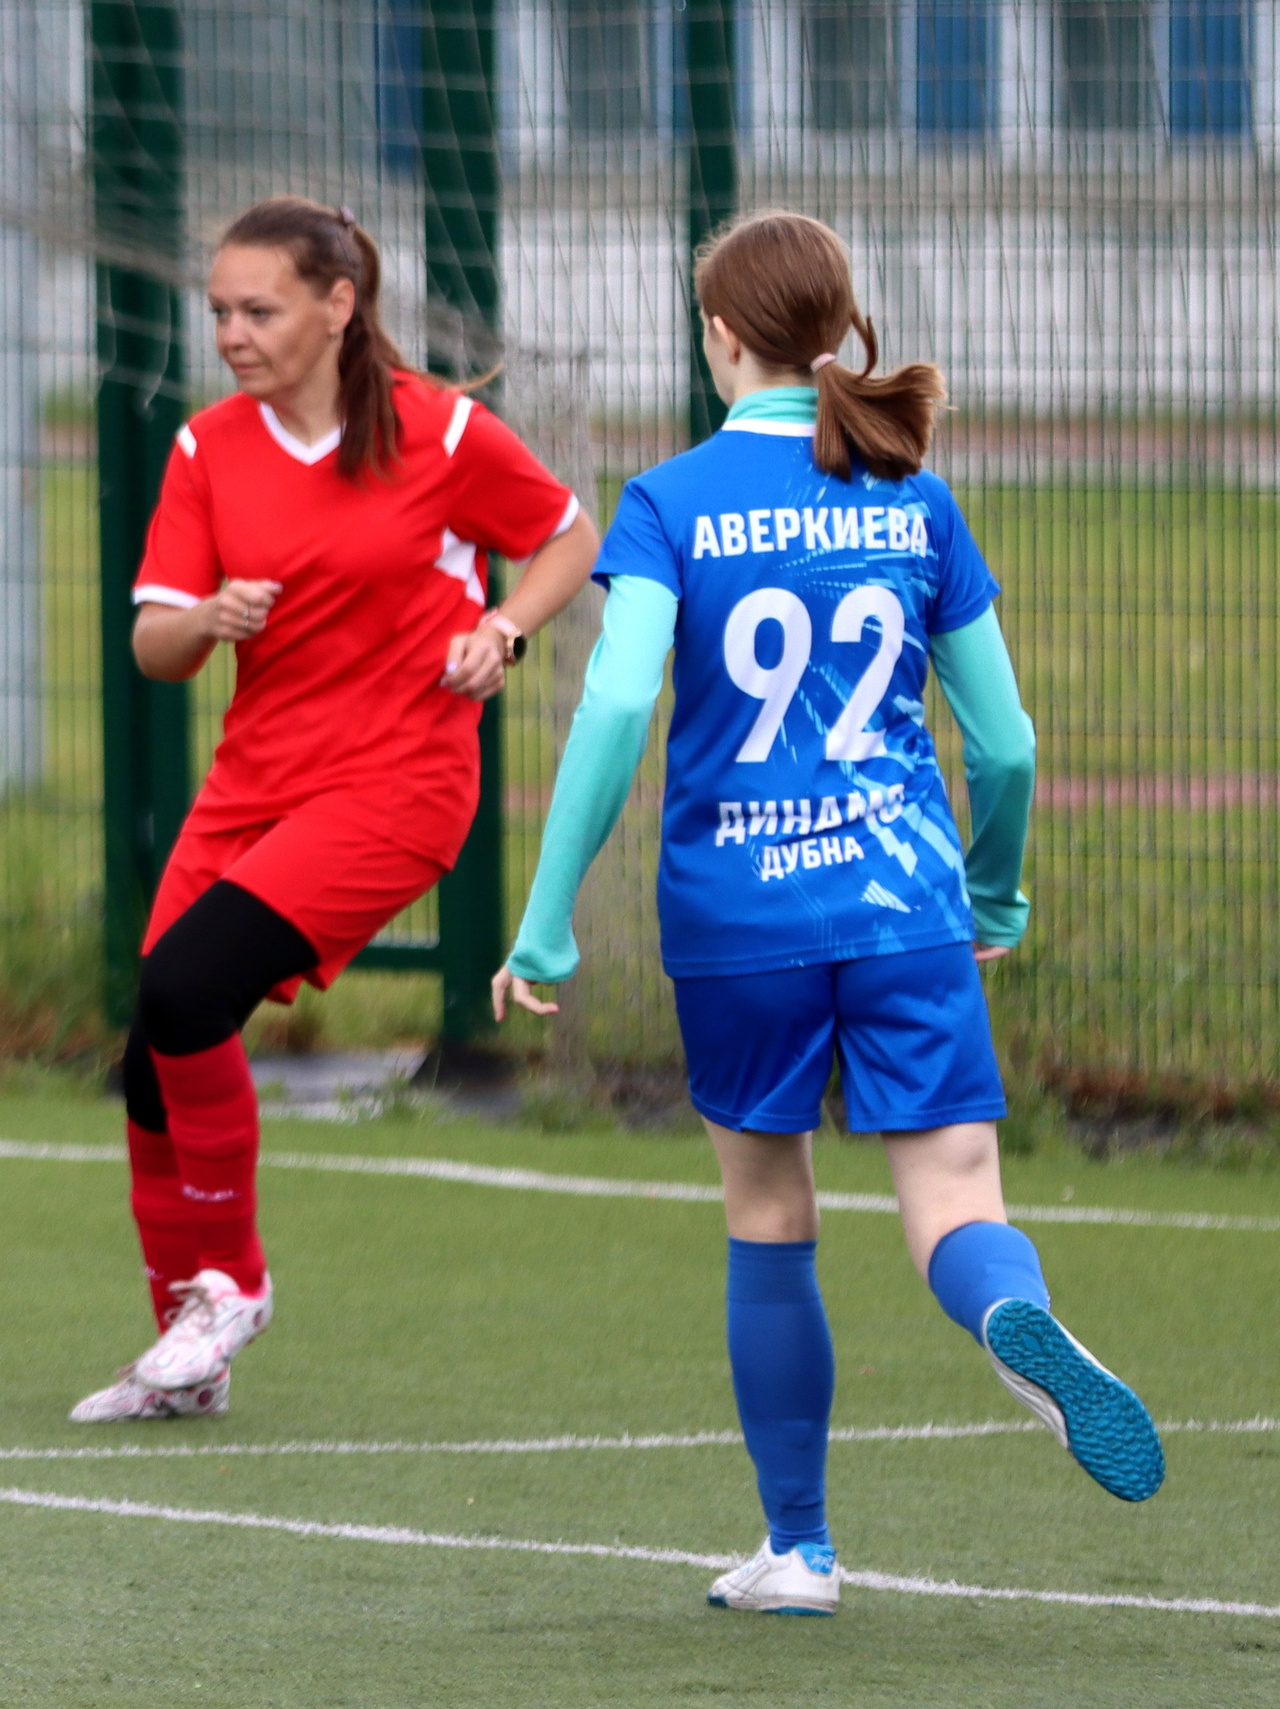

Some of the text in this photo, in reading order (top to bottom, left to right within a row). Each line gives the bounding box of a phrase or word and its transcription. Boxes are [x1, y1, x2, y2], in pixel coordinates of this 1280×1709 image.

[693, 507, 928, 558] АВЕРКИЕВА
[724, 586, 905, 762] 92
[715, 784, 905, 847] ДИНАМО
[761, 836, 865, 881] ДУБНА
